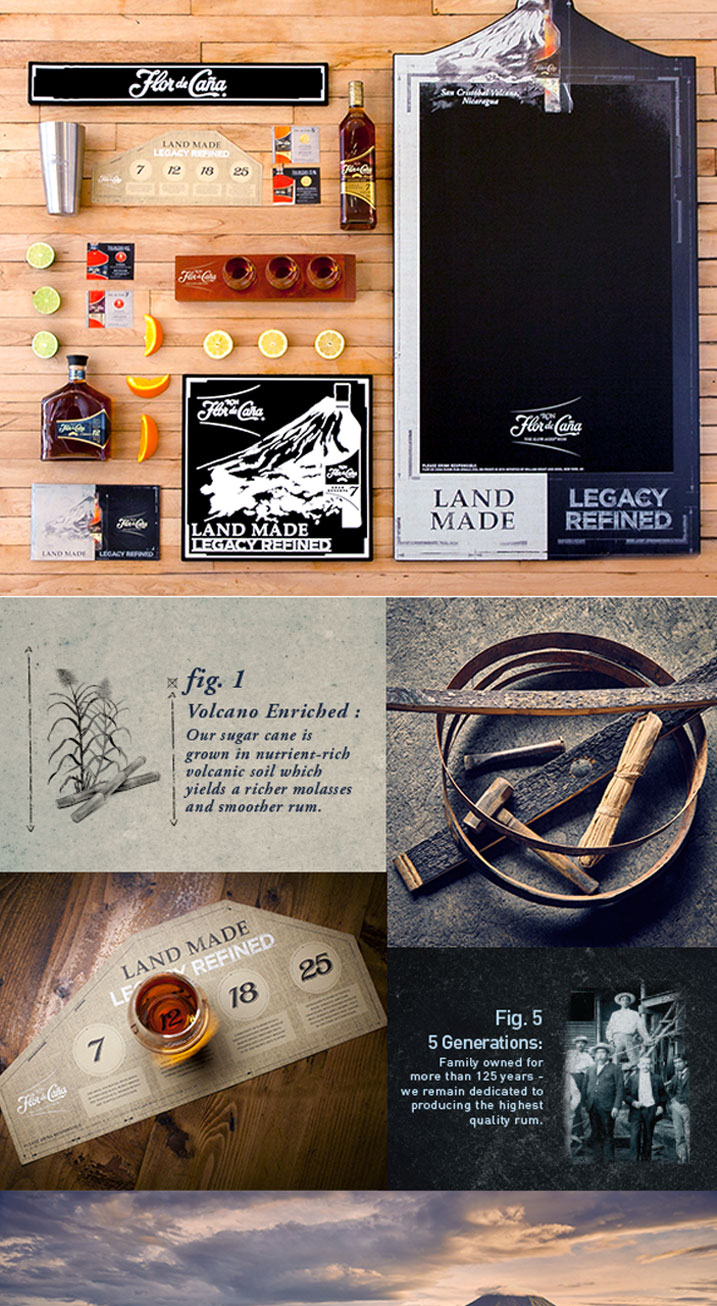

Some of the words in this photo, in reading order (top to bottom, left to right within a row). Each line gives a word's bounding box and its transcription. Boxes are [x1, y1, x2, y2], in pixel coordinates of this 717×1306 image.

[129, 69, 175, 98] Flor
[175, 76, 188, 88] de
[188, 69, 227, 97] Caña
[193, 141, 221, 149] MADE
[136, 165, 145, 175] 7
[168, 166, 181, 175] 12
[200, 166, 214, 176] 18
[233, 167, 249, 176] 25
[197, 400, 228, 421] Flor
[510, 415, 544, 437] Flor
[545, 420, 553, 429] de
[554, 414, 582, 436] Caña
[350, 487, 359, 496] 7
[434, 489, 515, 507] LAND
[569, 488, 671, 508] LEGACY
[192, 523, 246, 537] LAND
[252, 523, 309, 537] MADE
[430, 512, 515, 530] MADE
[566, 510, 673, 531] REFINED
[192, 538, 255, 552] LEGACY
[261, 538, 331, 552] REFINED
[121, 947, 182, 980] LAND
[186, 920, 250, 955] MADE
[192, 933, 275, 976] REFINED
[299, 953, 332, 982] 25
[229, 982, 259, 1008] 18
[160, 1008, 183, 1031] 12
[87, 1036, 105, 1062] 7
